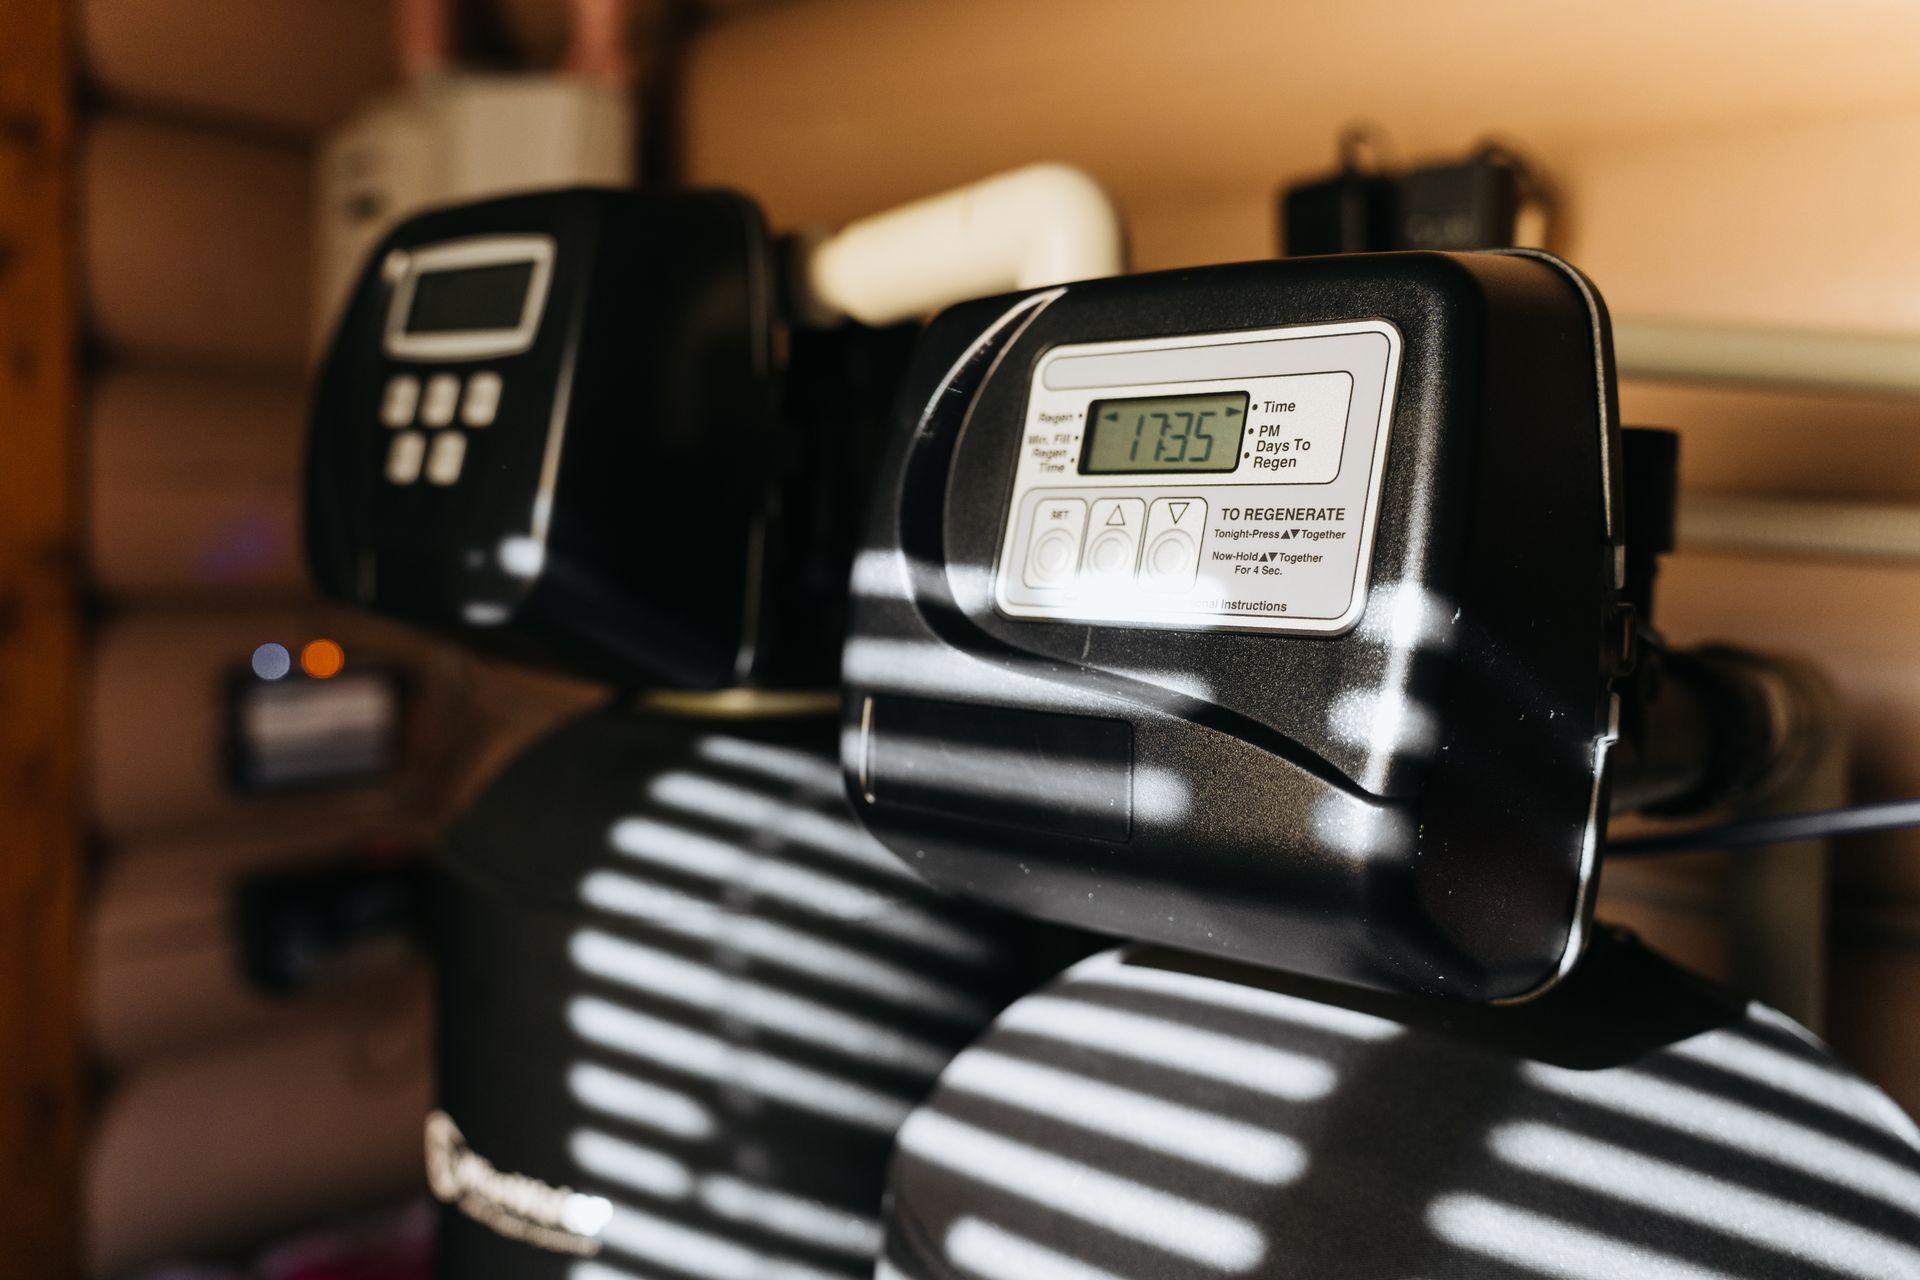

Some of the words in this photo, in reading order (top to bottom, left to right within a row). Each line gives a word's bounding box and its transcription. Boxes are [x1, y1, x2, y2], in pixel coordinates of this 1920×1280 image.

[1263, 401, 1296, 413] Time
[1258, 425, 1281, 437] PM
[1256, 440, 1290, 455] Days
[1294, 438, 1311, 451] To
[1253, 456, 1297, 471] Regen
[1051, 510, 1070, 520] SET
[1221, 507, 1240, 521] TO
[1244, 507, 1346, 521] REGENERATE
[1214, 529, 1280, 541] Tonight-Press
[1301, 529, 1346, 541] Together
[1212, 551, 1259, 561] Now-Hold
[1279, 552, 1324, 564] Together
[1234, 565, 1251, 574] For
[1253, 565, 1259, 574] 4
[1261, 565, 1283, 575] Sec.
[1221, 599, 1287, 612] Instructions
